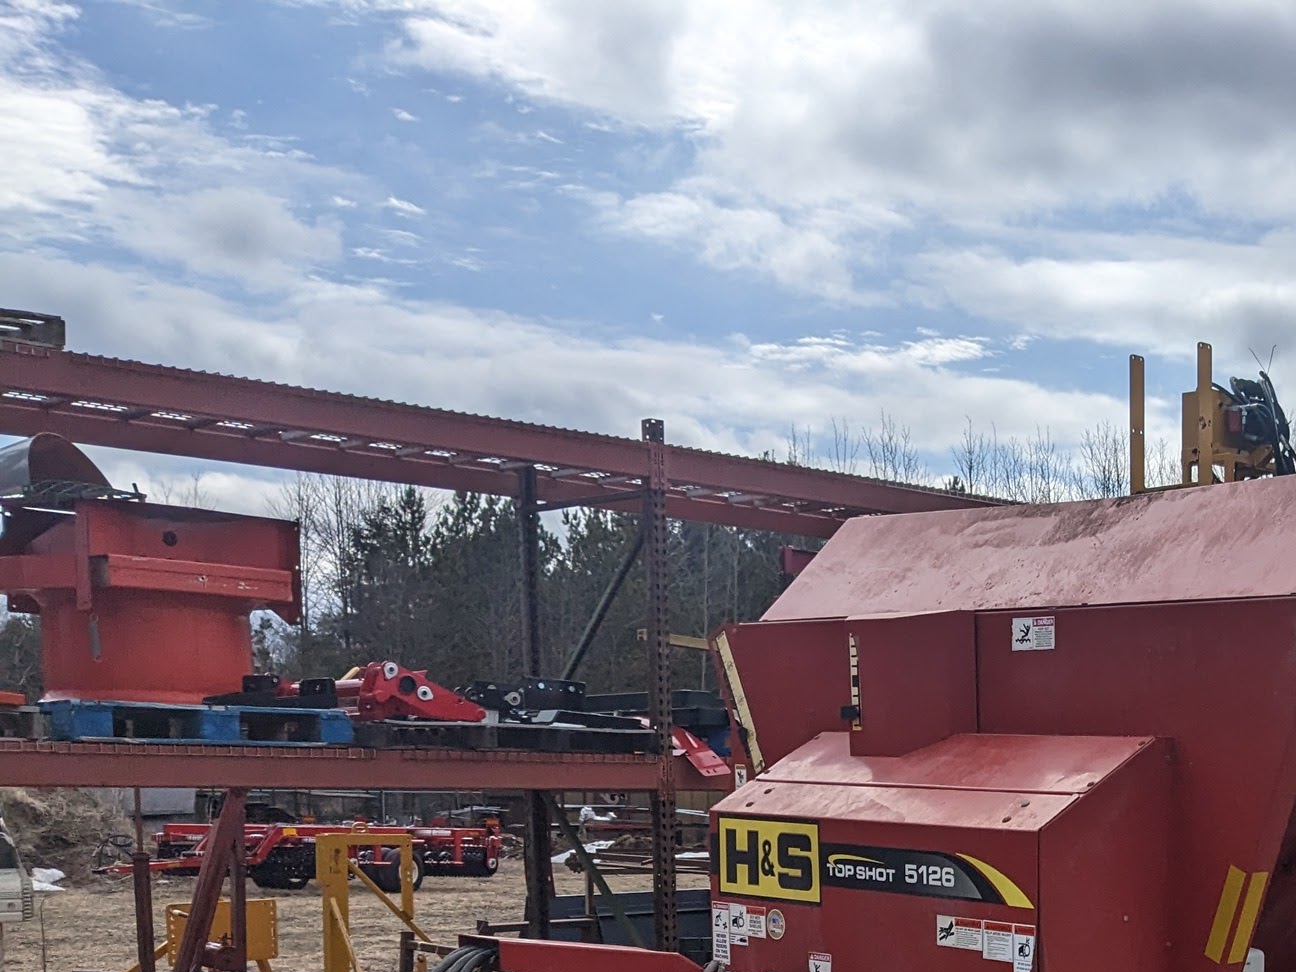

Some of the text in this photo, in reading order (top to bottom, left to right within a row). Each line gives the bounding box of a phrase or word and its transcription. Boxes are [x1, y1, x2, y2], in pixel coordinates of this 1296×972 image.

[725, 828, 956, 891] H&S TOP SHOT 5126
